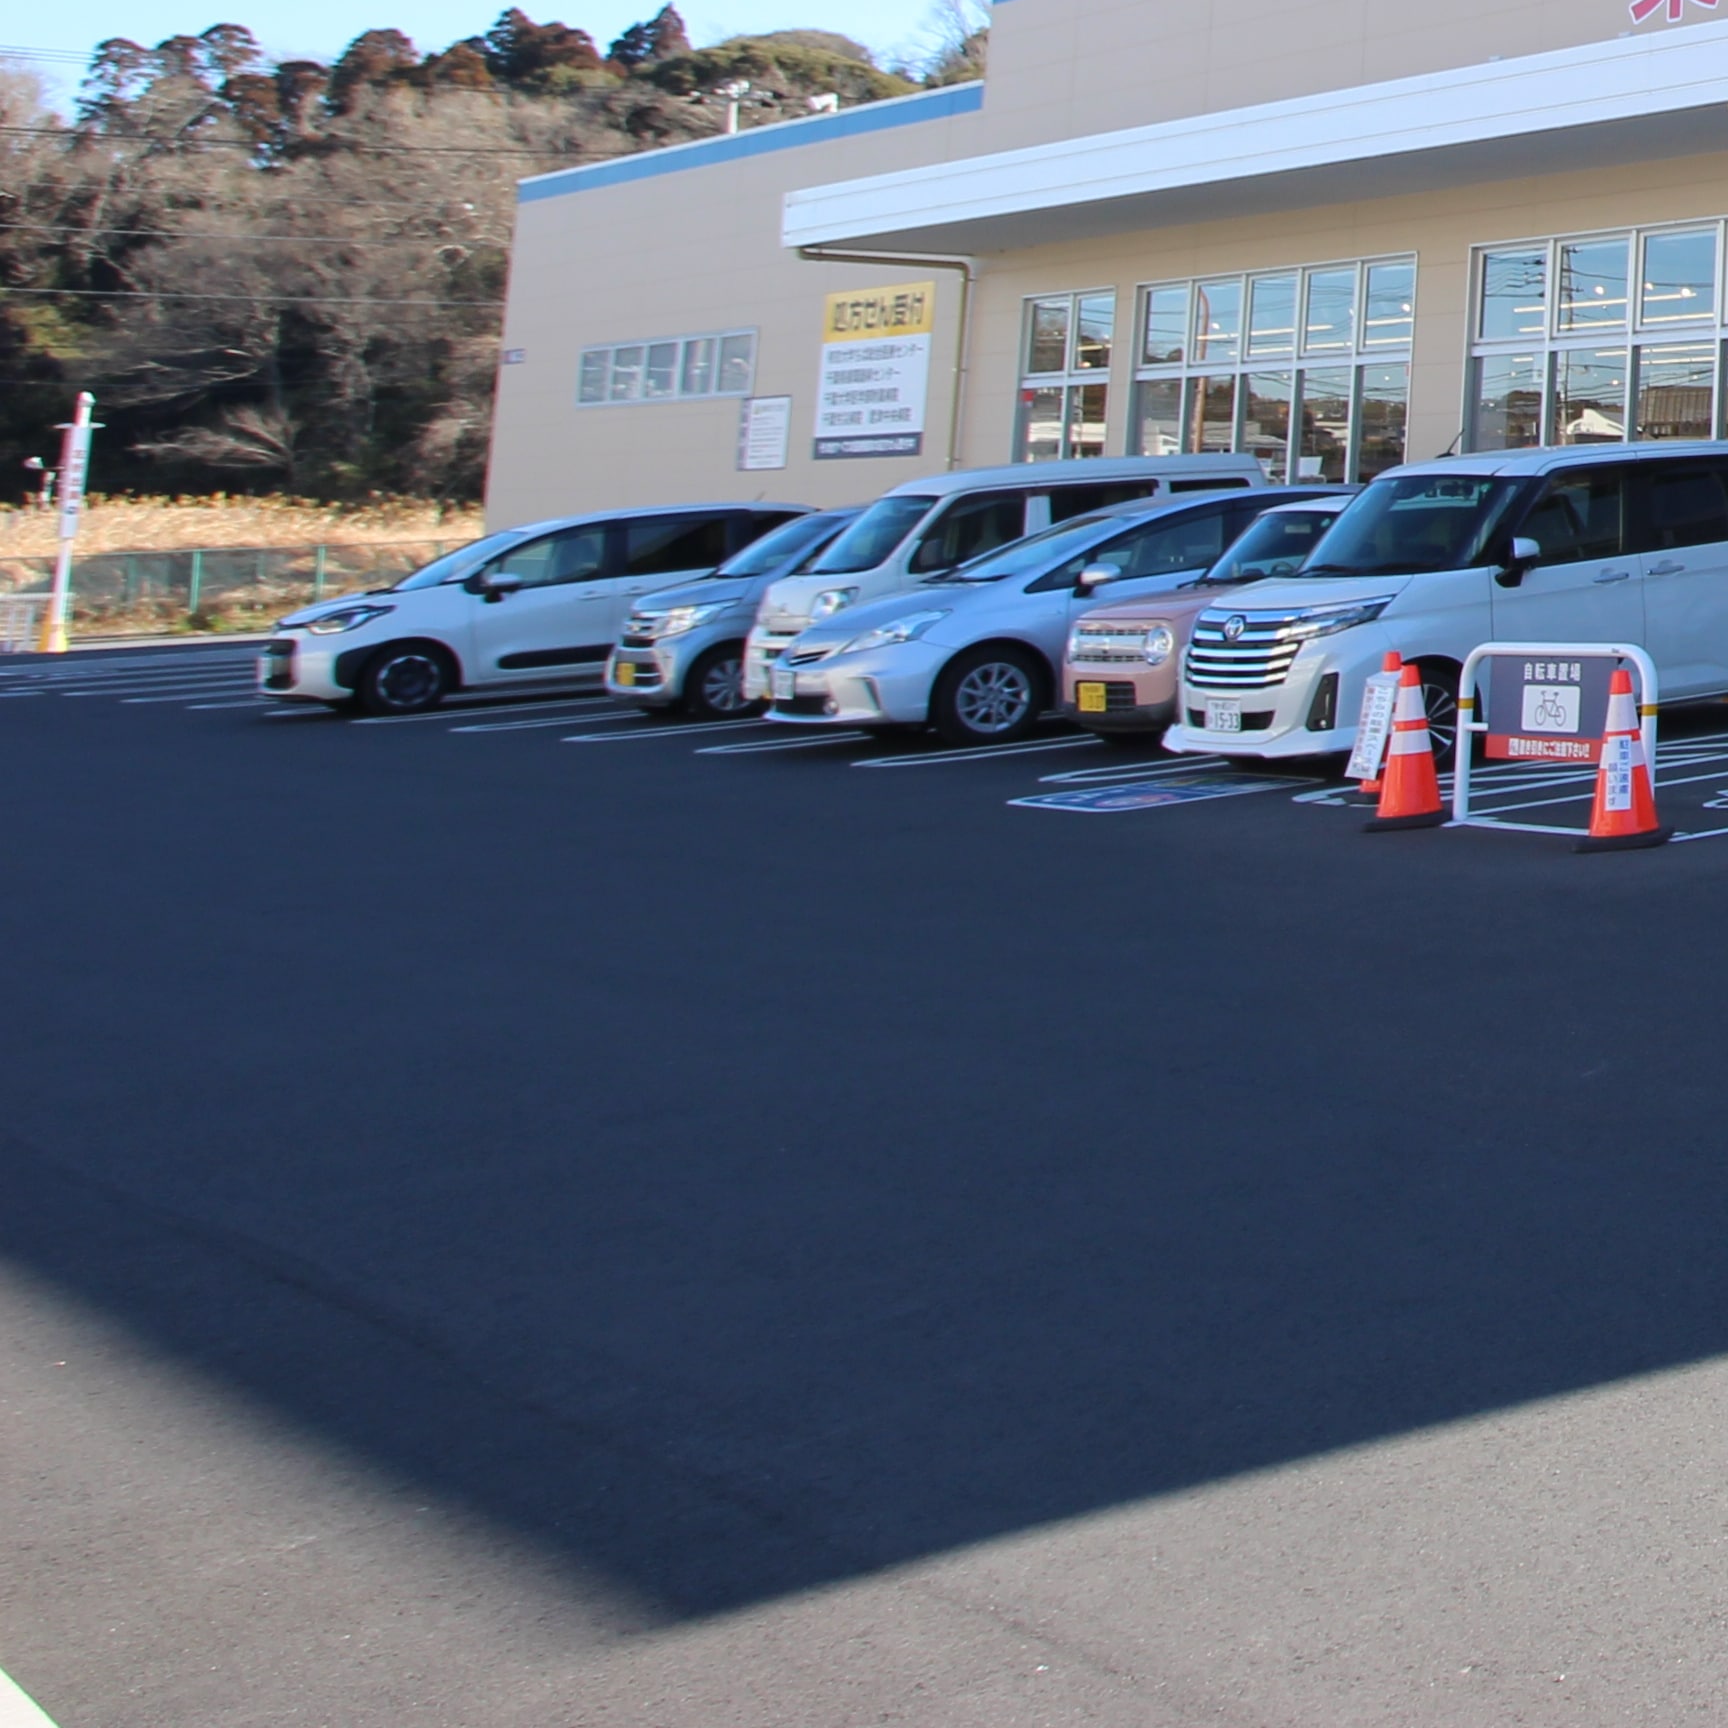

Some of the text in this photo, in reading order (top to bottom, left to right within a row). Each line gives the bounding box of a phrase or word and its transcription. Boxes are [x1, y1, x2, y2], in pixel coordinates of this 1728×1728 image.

[1524, 662, 1581, 681] 自転車置場
